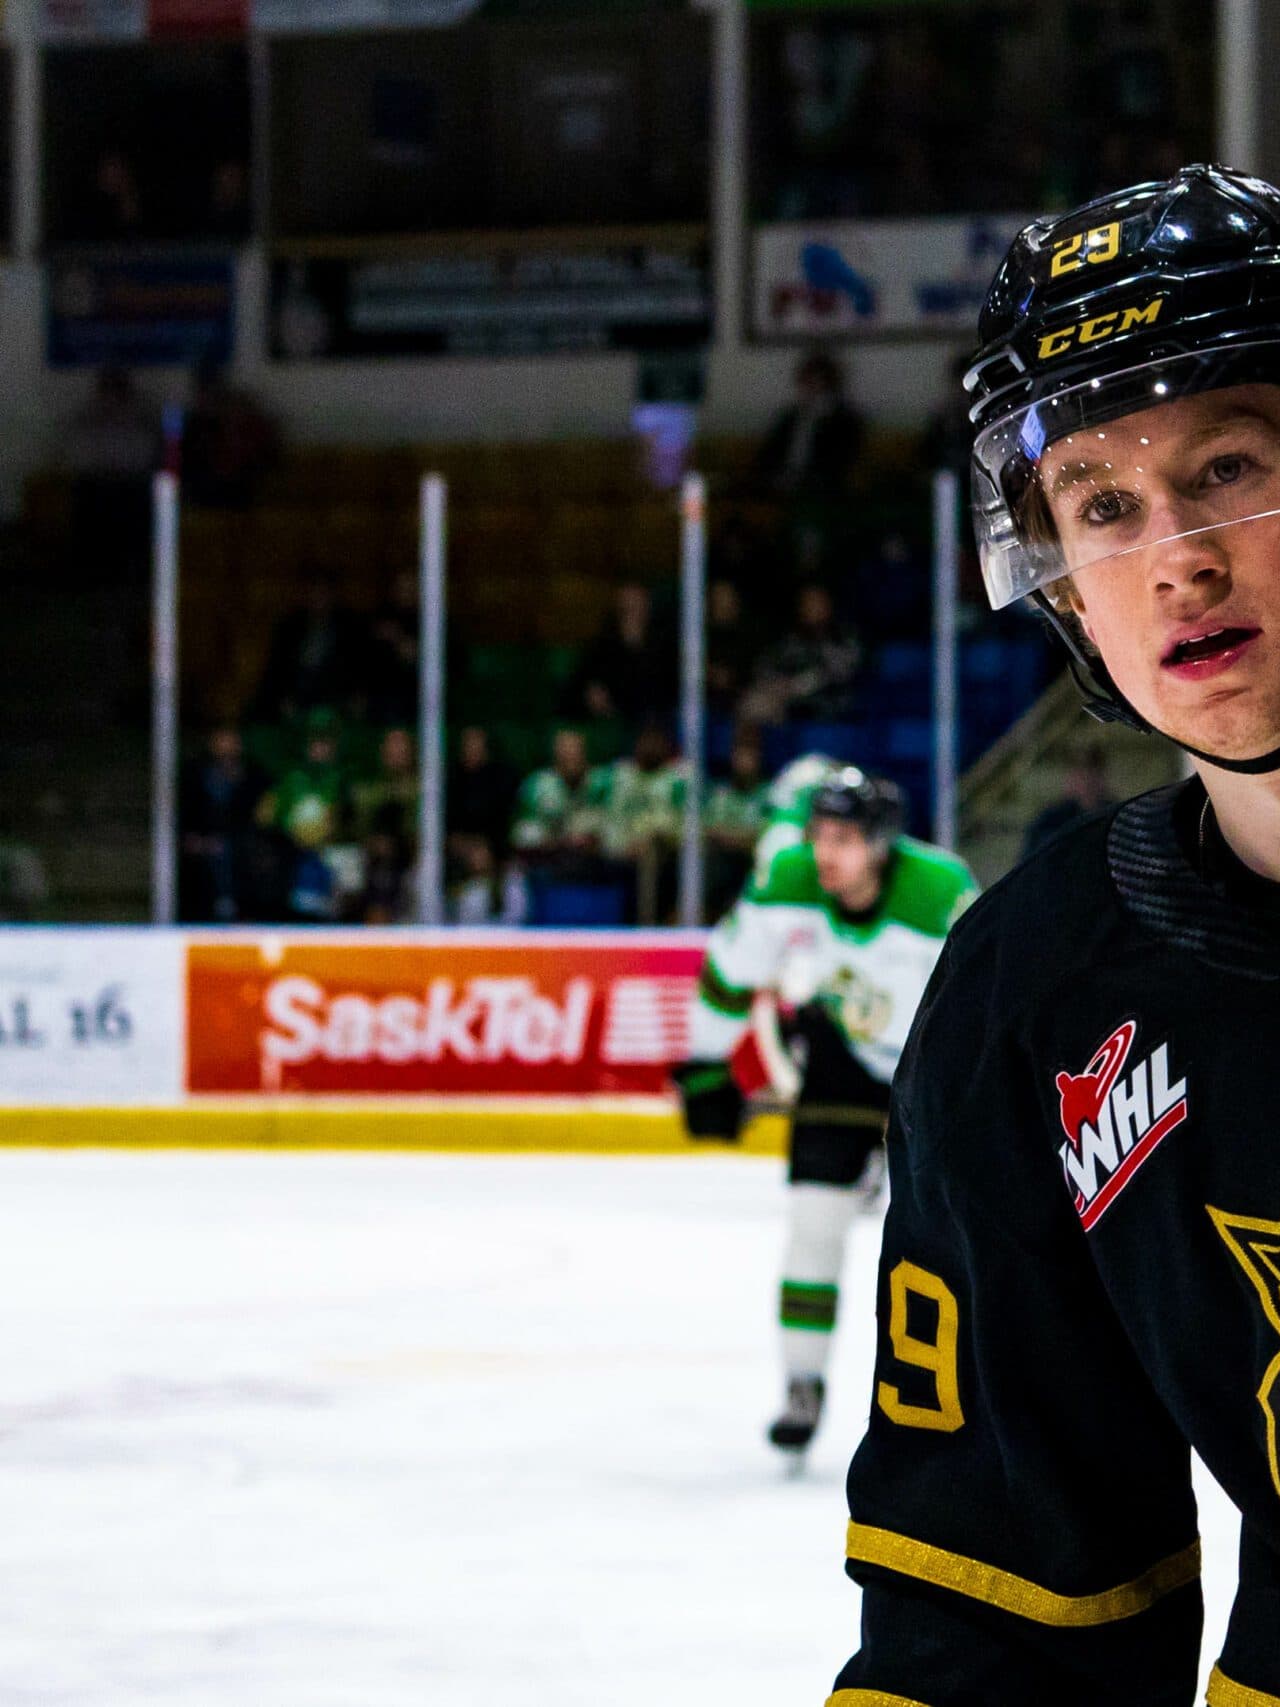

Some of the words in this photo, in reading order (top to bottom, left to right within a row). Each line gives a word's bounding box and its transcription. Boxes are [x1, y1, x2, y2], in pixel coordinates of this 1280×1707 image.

[1051, 222, 1120, 278] 29
[1037, 299, 1163, 360] CCM
[67, 981, 133, 1047] 16
[263, 976, 593, 1064] SaskTel
[1059, 1042, 1187, 1202] WHL
[877, 1258, 966, 1433] 9
